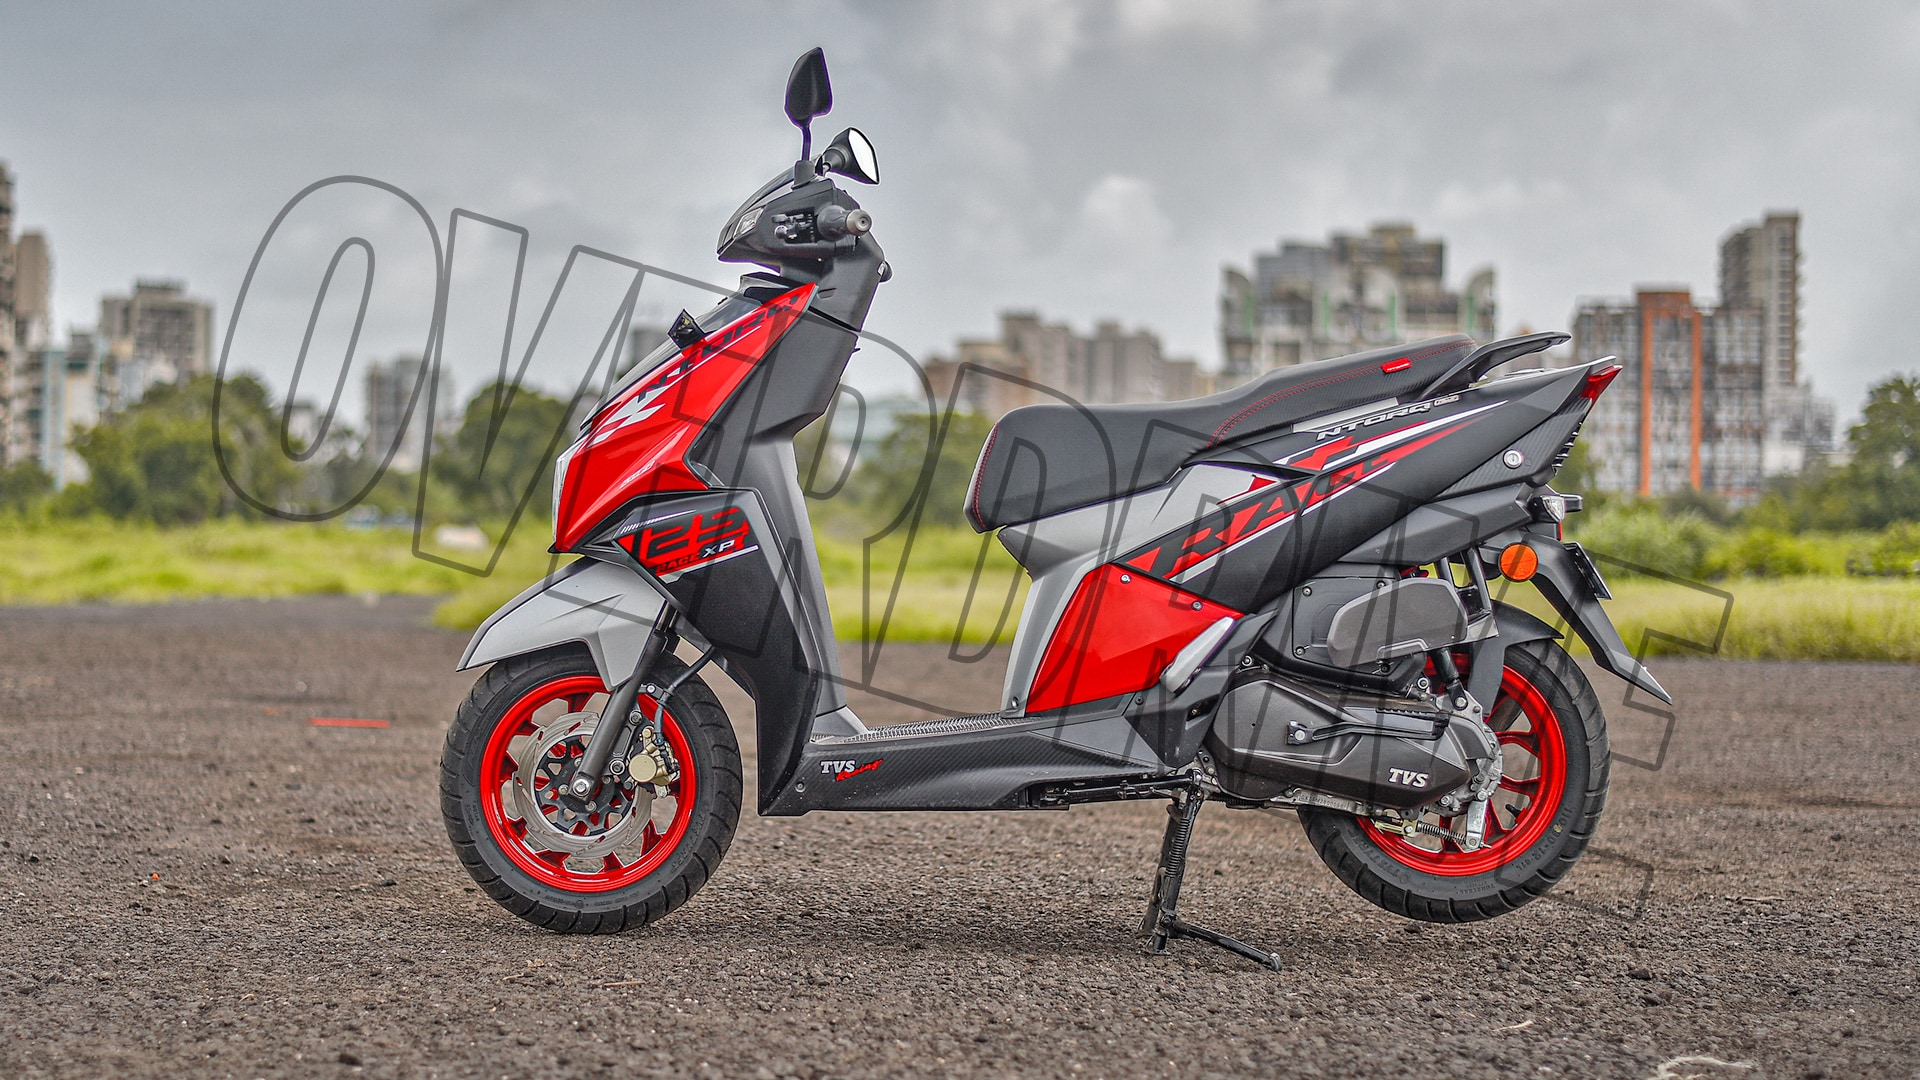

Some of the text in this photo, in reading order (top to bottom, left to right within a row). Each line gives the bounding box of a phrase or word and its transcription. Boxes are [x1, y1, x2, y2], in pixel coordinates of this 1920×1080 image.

[1316, 402, 1431, 441] NTORQ
[703, 539, 735, 558] XP
[820, 760, 856, 774] TVS
[1388, 767, 1429, 788] TVS
